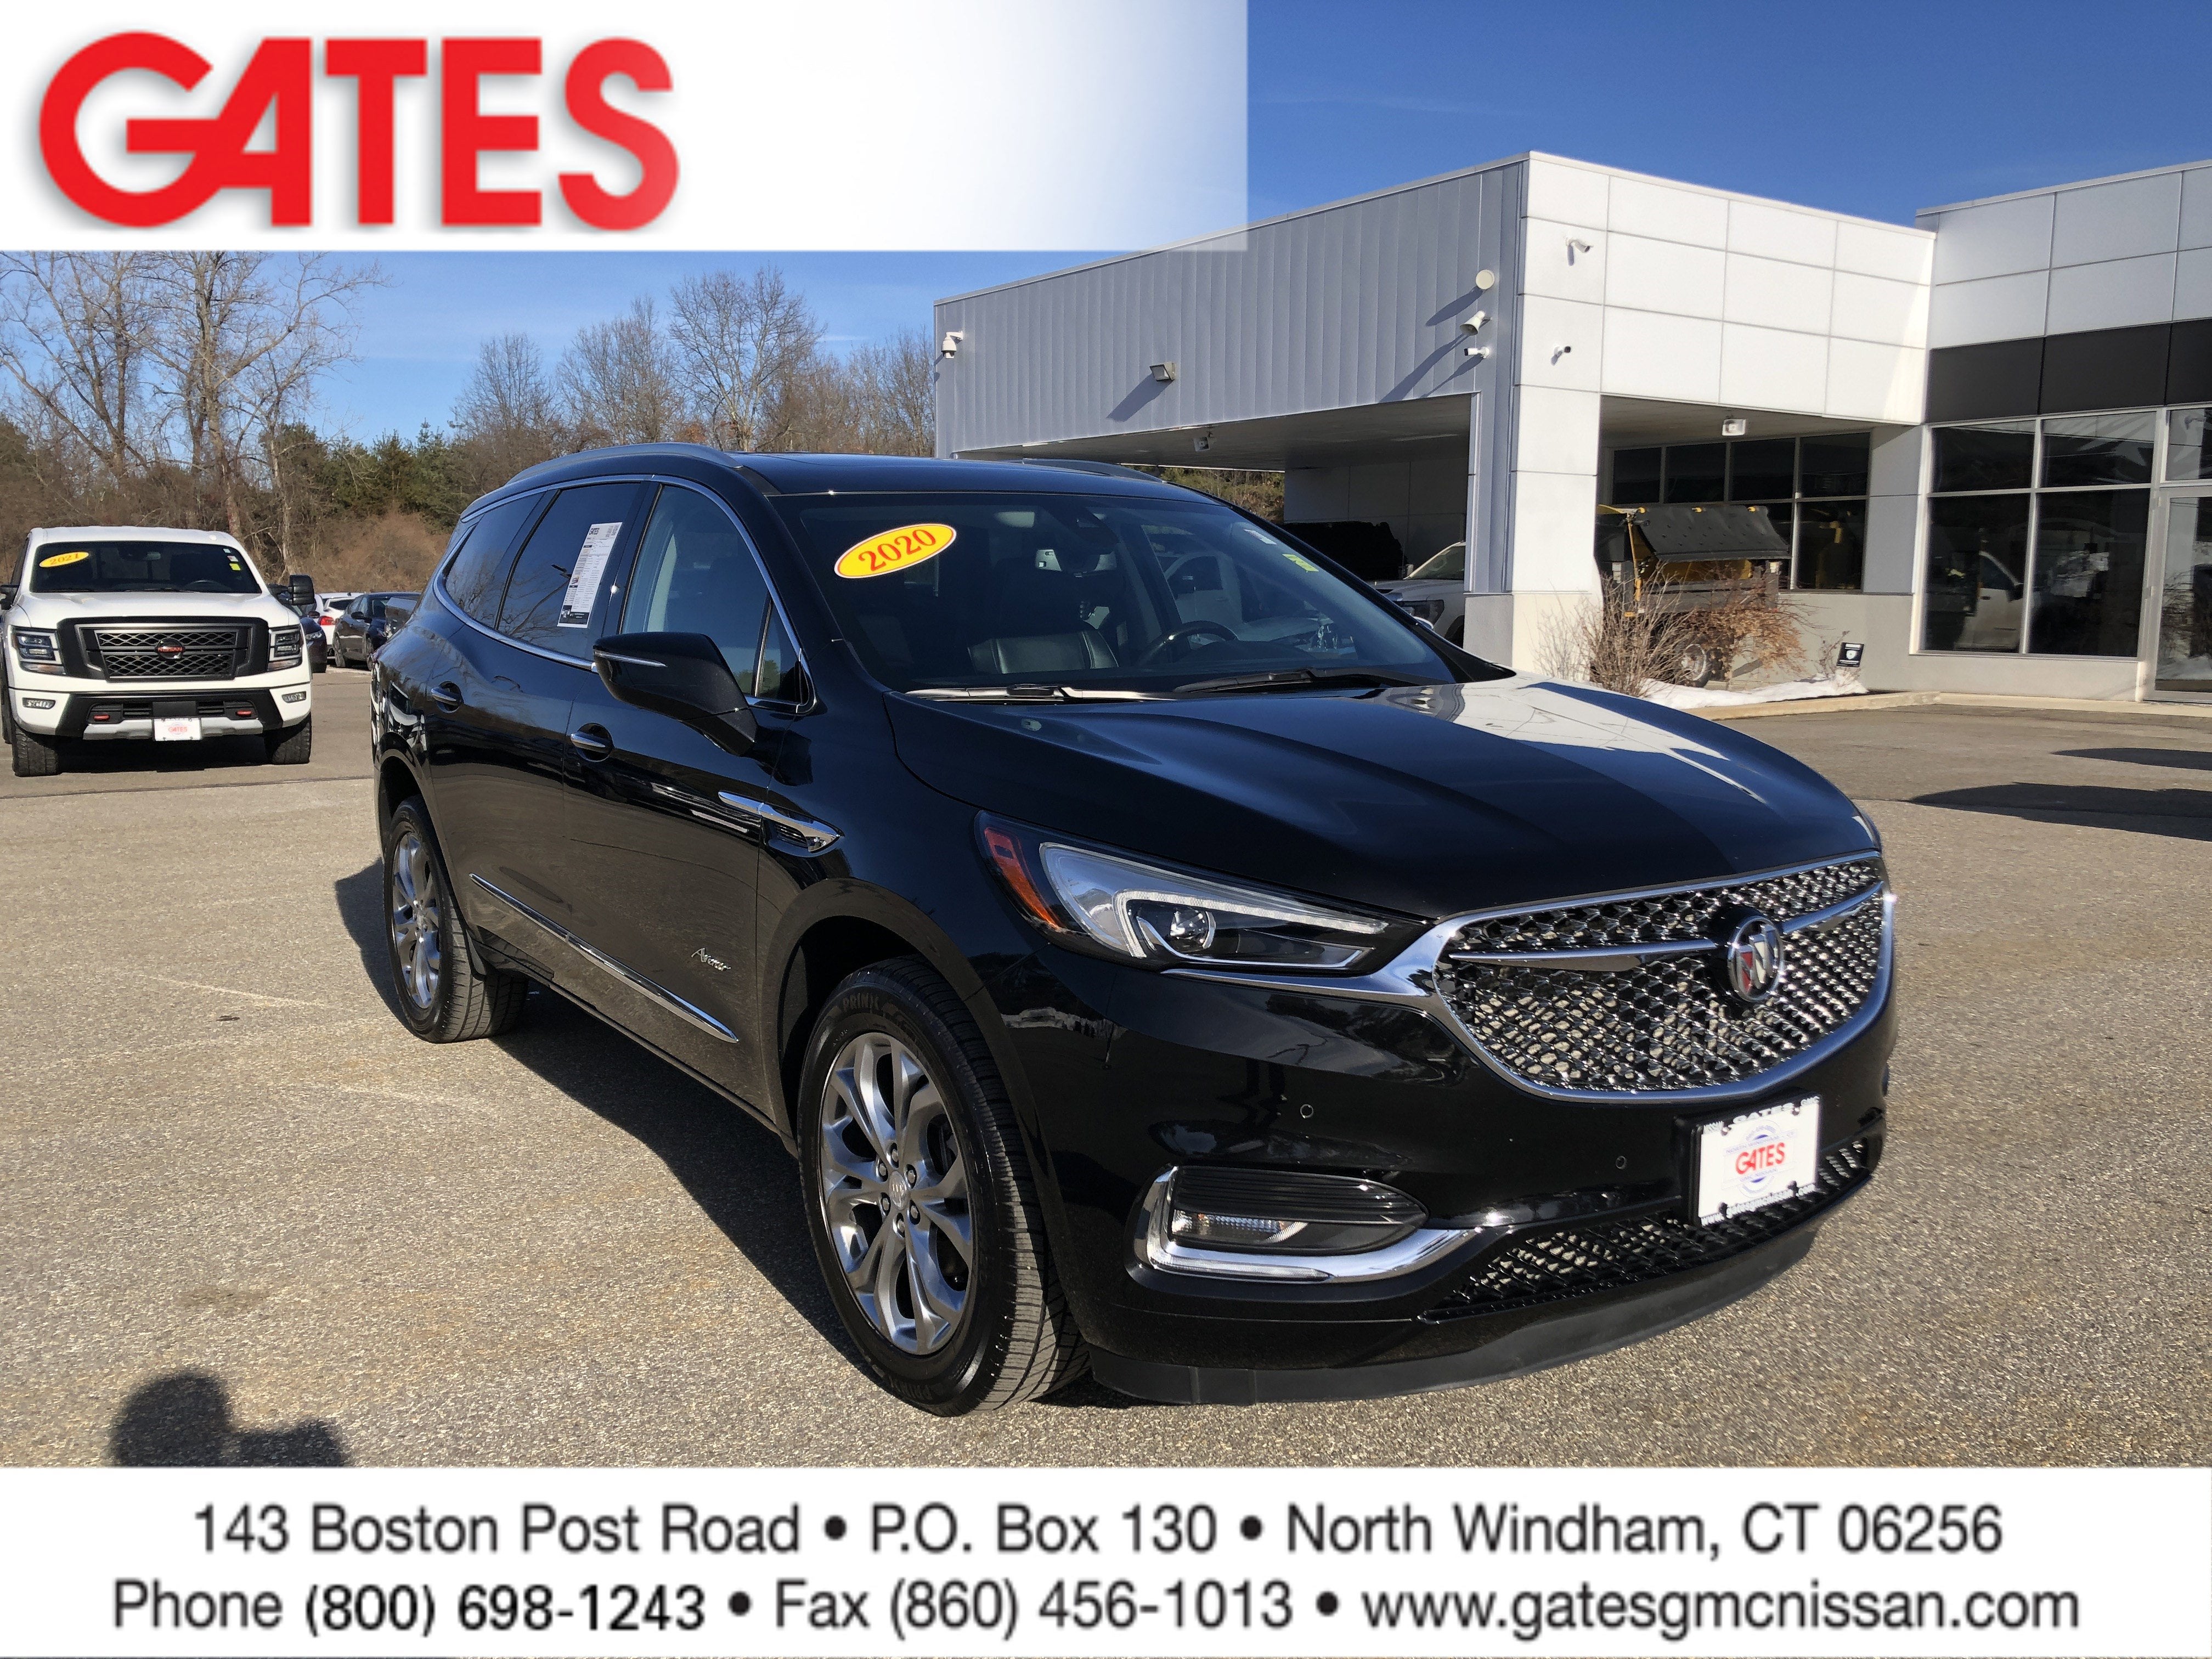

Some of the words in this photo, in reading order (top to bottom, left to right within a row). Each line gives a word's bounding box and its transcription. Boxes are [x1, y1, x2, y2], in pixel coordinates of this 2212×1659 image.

[49, 552, 80, 565] 2021
[857, 529, 937, 572] 2020
[1736, 1142, 1785, 1175] GATES
